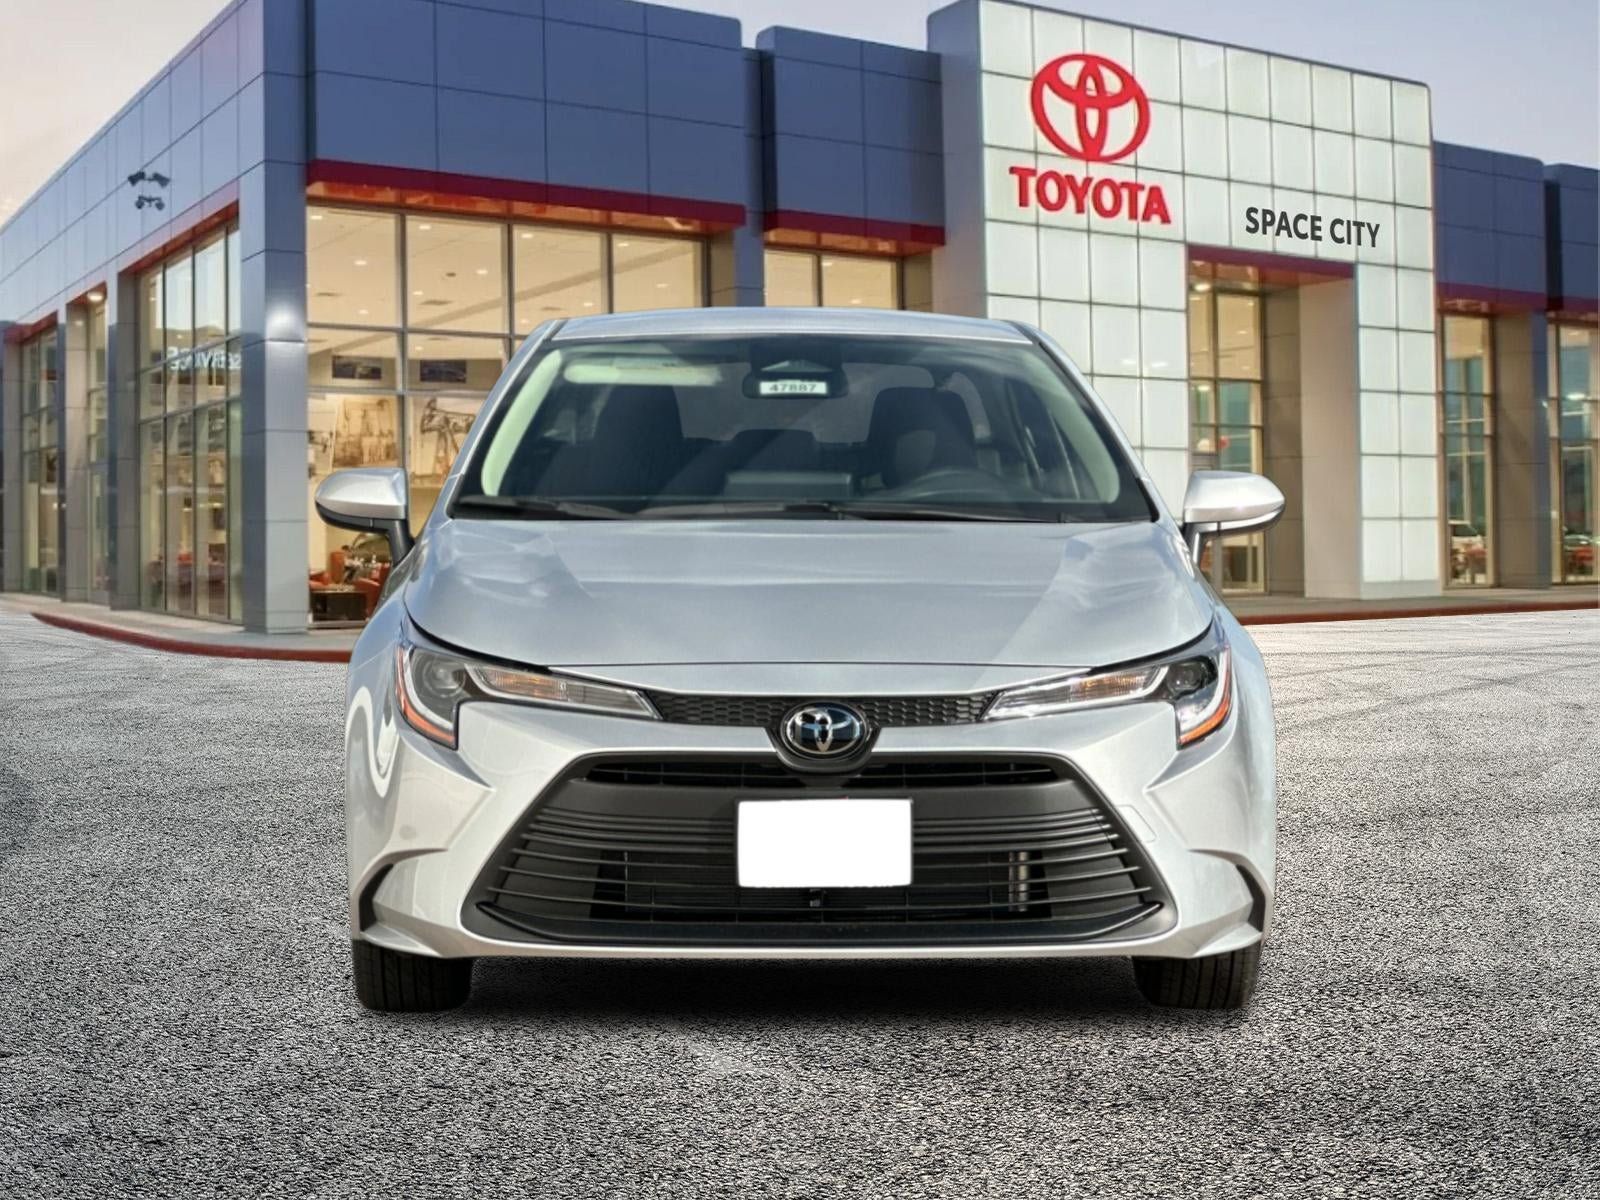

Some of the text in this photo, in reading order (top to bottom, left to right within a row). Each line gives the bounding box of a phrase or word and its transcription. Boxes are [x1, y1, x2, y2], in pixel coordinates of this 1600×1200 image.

[1009, 166, 1171, 224] TOYOTA
[1245, 207, 1381, 249] SPACE CITY
